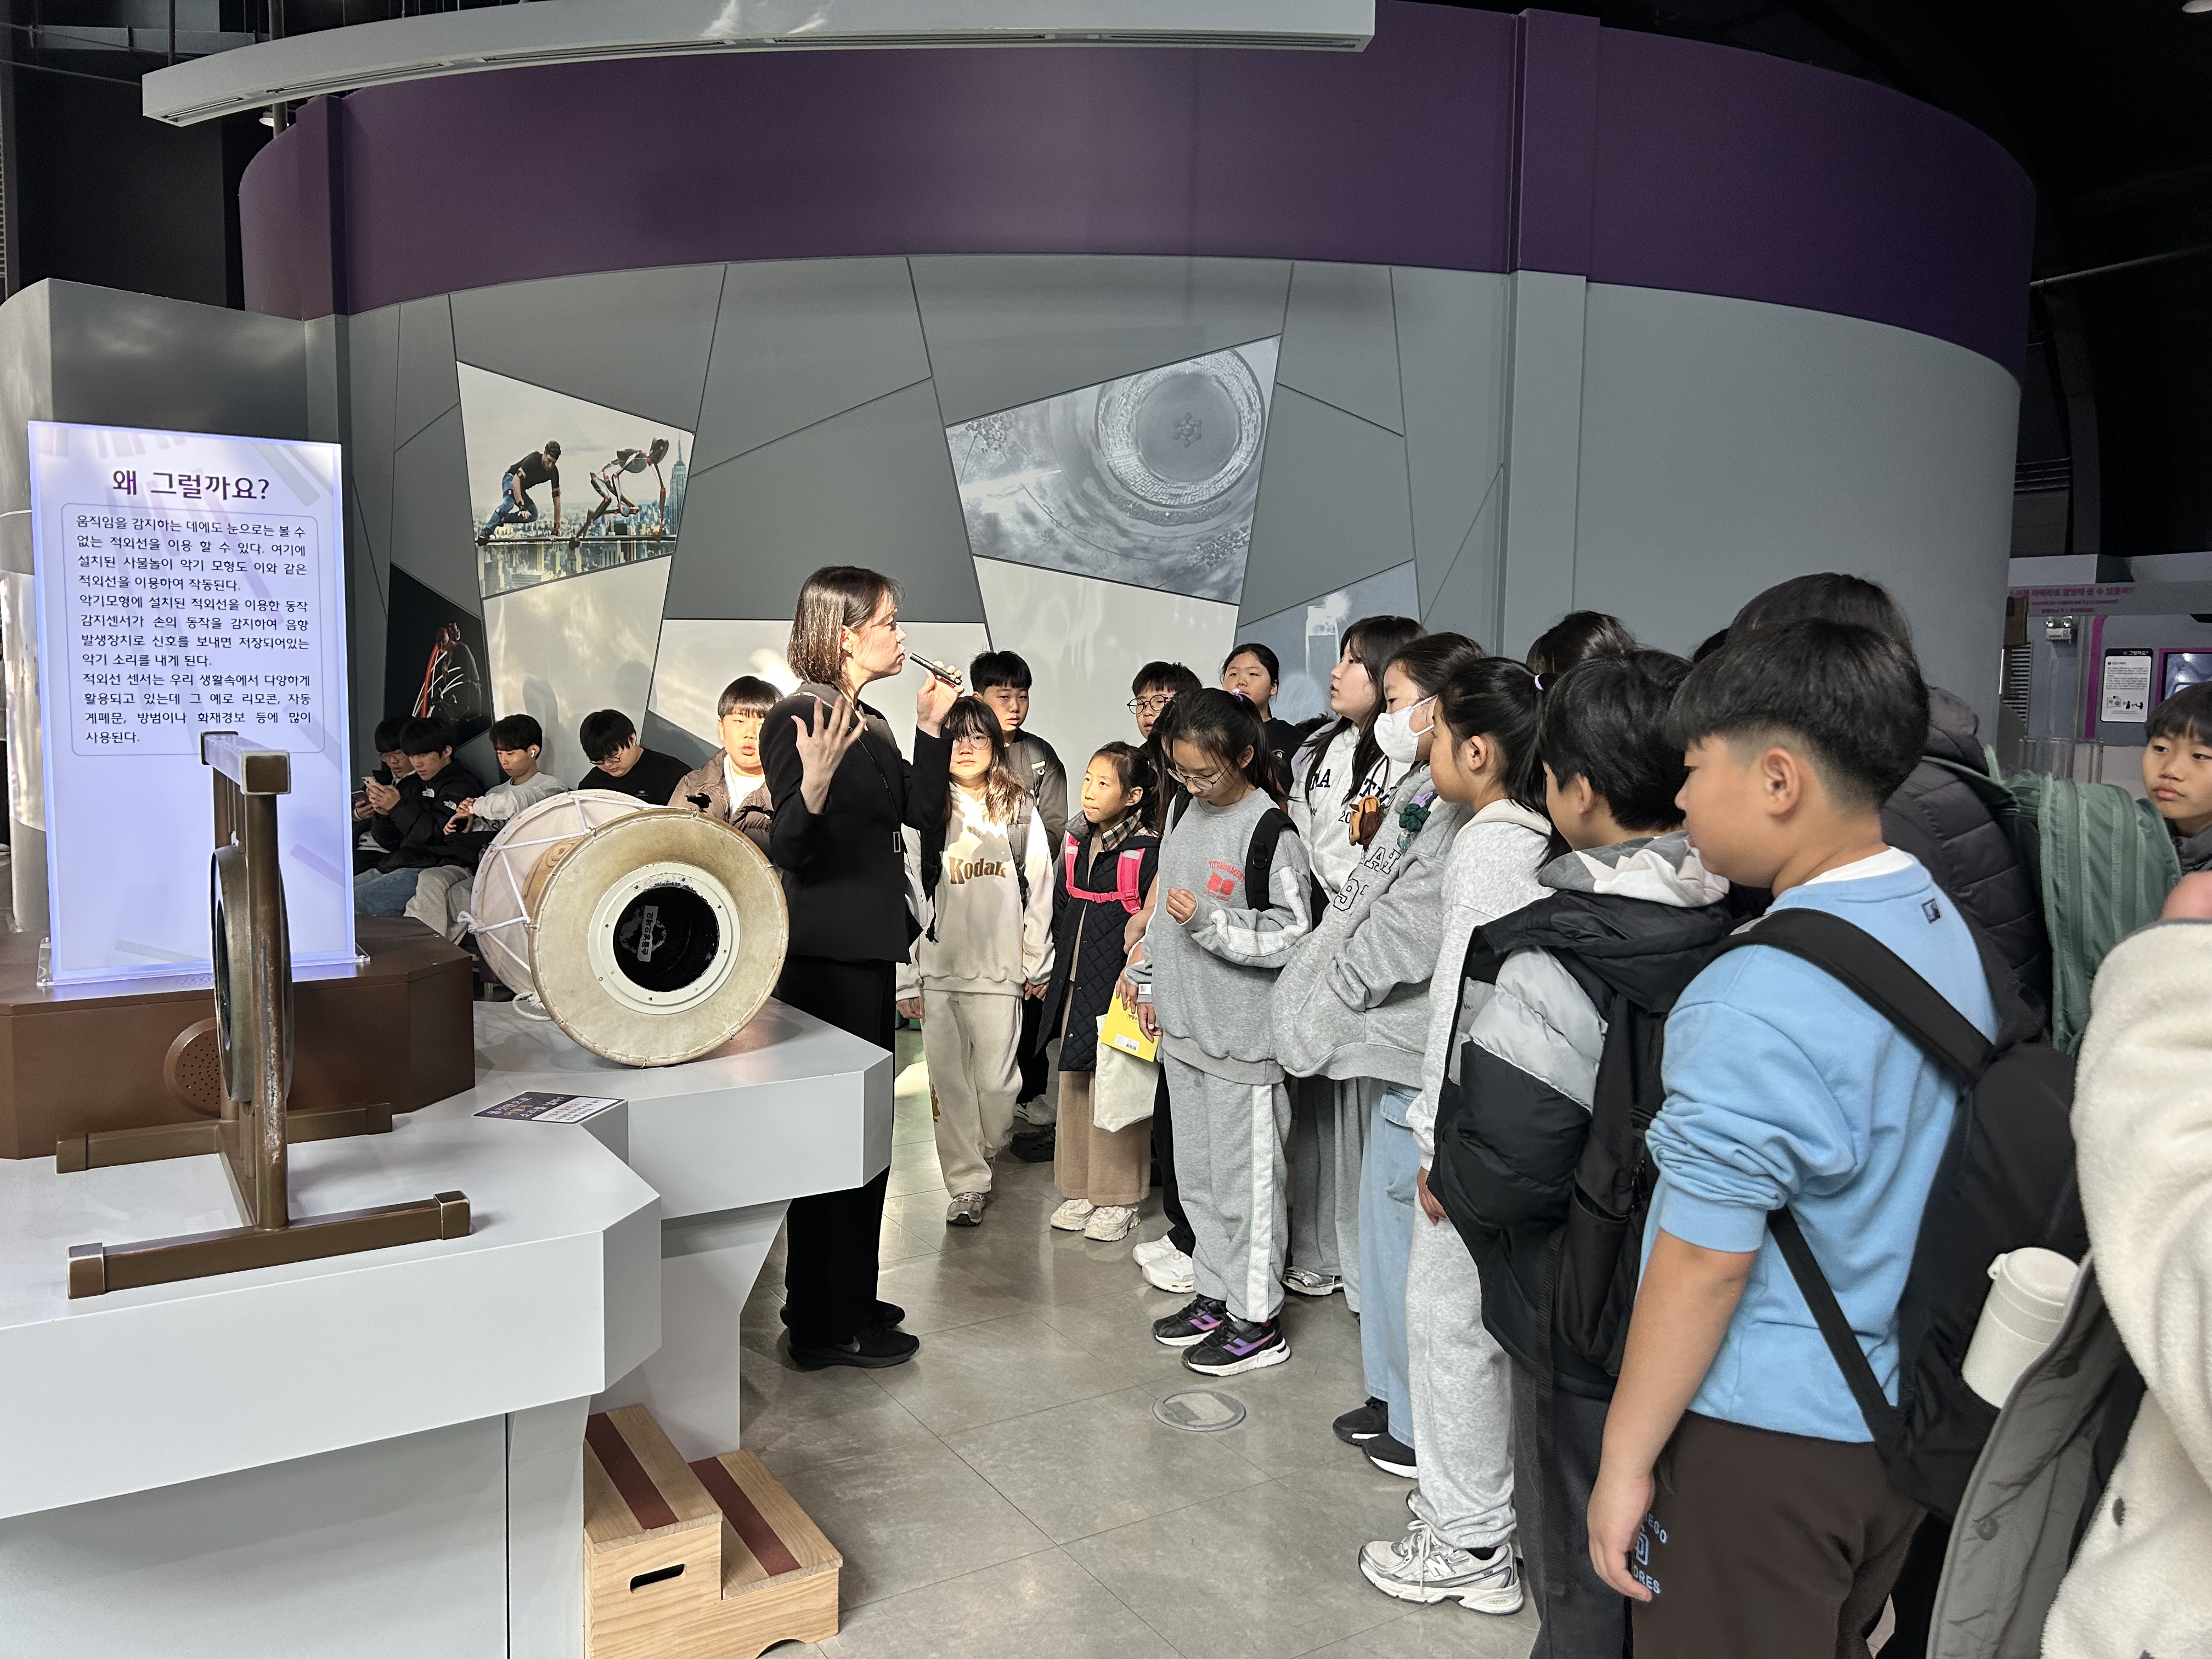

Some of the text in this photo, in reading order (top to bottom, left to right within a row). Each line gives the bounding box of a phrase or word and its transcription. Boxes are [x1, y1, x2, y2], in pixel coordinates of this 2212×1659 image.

[112, 470, 269, 501] 왜 그럴까요?
[76, 515, 306, 538] 움직임을 감지하는 데에도 눈으로는 볼 수
[77, 535, 306, 557] 없는 적외선을 이용 할 수 있다. 여기에
[77, 555, 307, 575] 설치된 사물놀이 악기 모형도 이와 같은
[78, 575, 241, 592] 적외선을 이용하여 작동된다.
[80, 595, 308, 613] 악기모형에 설치된 적외선을 이용한 동작
[81, 614, 309, 631] 감지센서가 손의 동작을 감지하여 음향
[81, 634, 309, 650] 발생장치로 신호를 보내면 저장되어있는
[82, 653, 212, 667] 악기 소리를 내게 된다.
[83, 673, 310, 687] 적외선 센서는 우리 생활속에서 다양하게
[84, 693, 311, 706] 활용되고 있는데 그 예로 리모콘, 자동
[137, 712, 187, 725] 방범이나
[197, 712, 246, 724] 화재경보
[256, 712, 278, 724] 등에
[289, 712, 311, 724] 많이
[86, 731, 140, 744] 사용된다.
[949, 856, 1007, 884] Kodak
